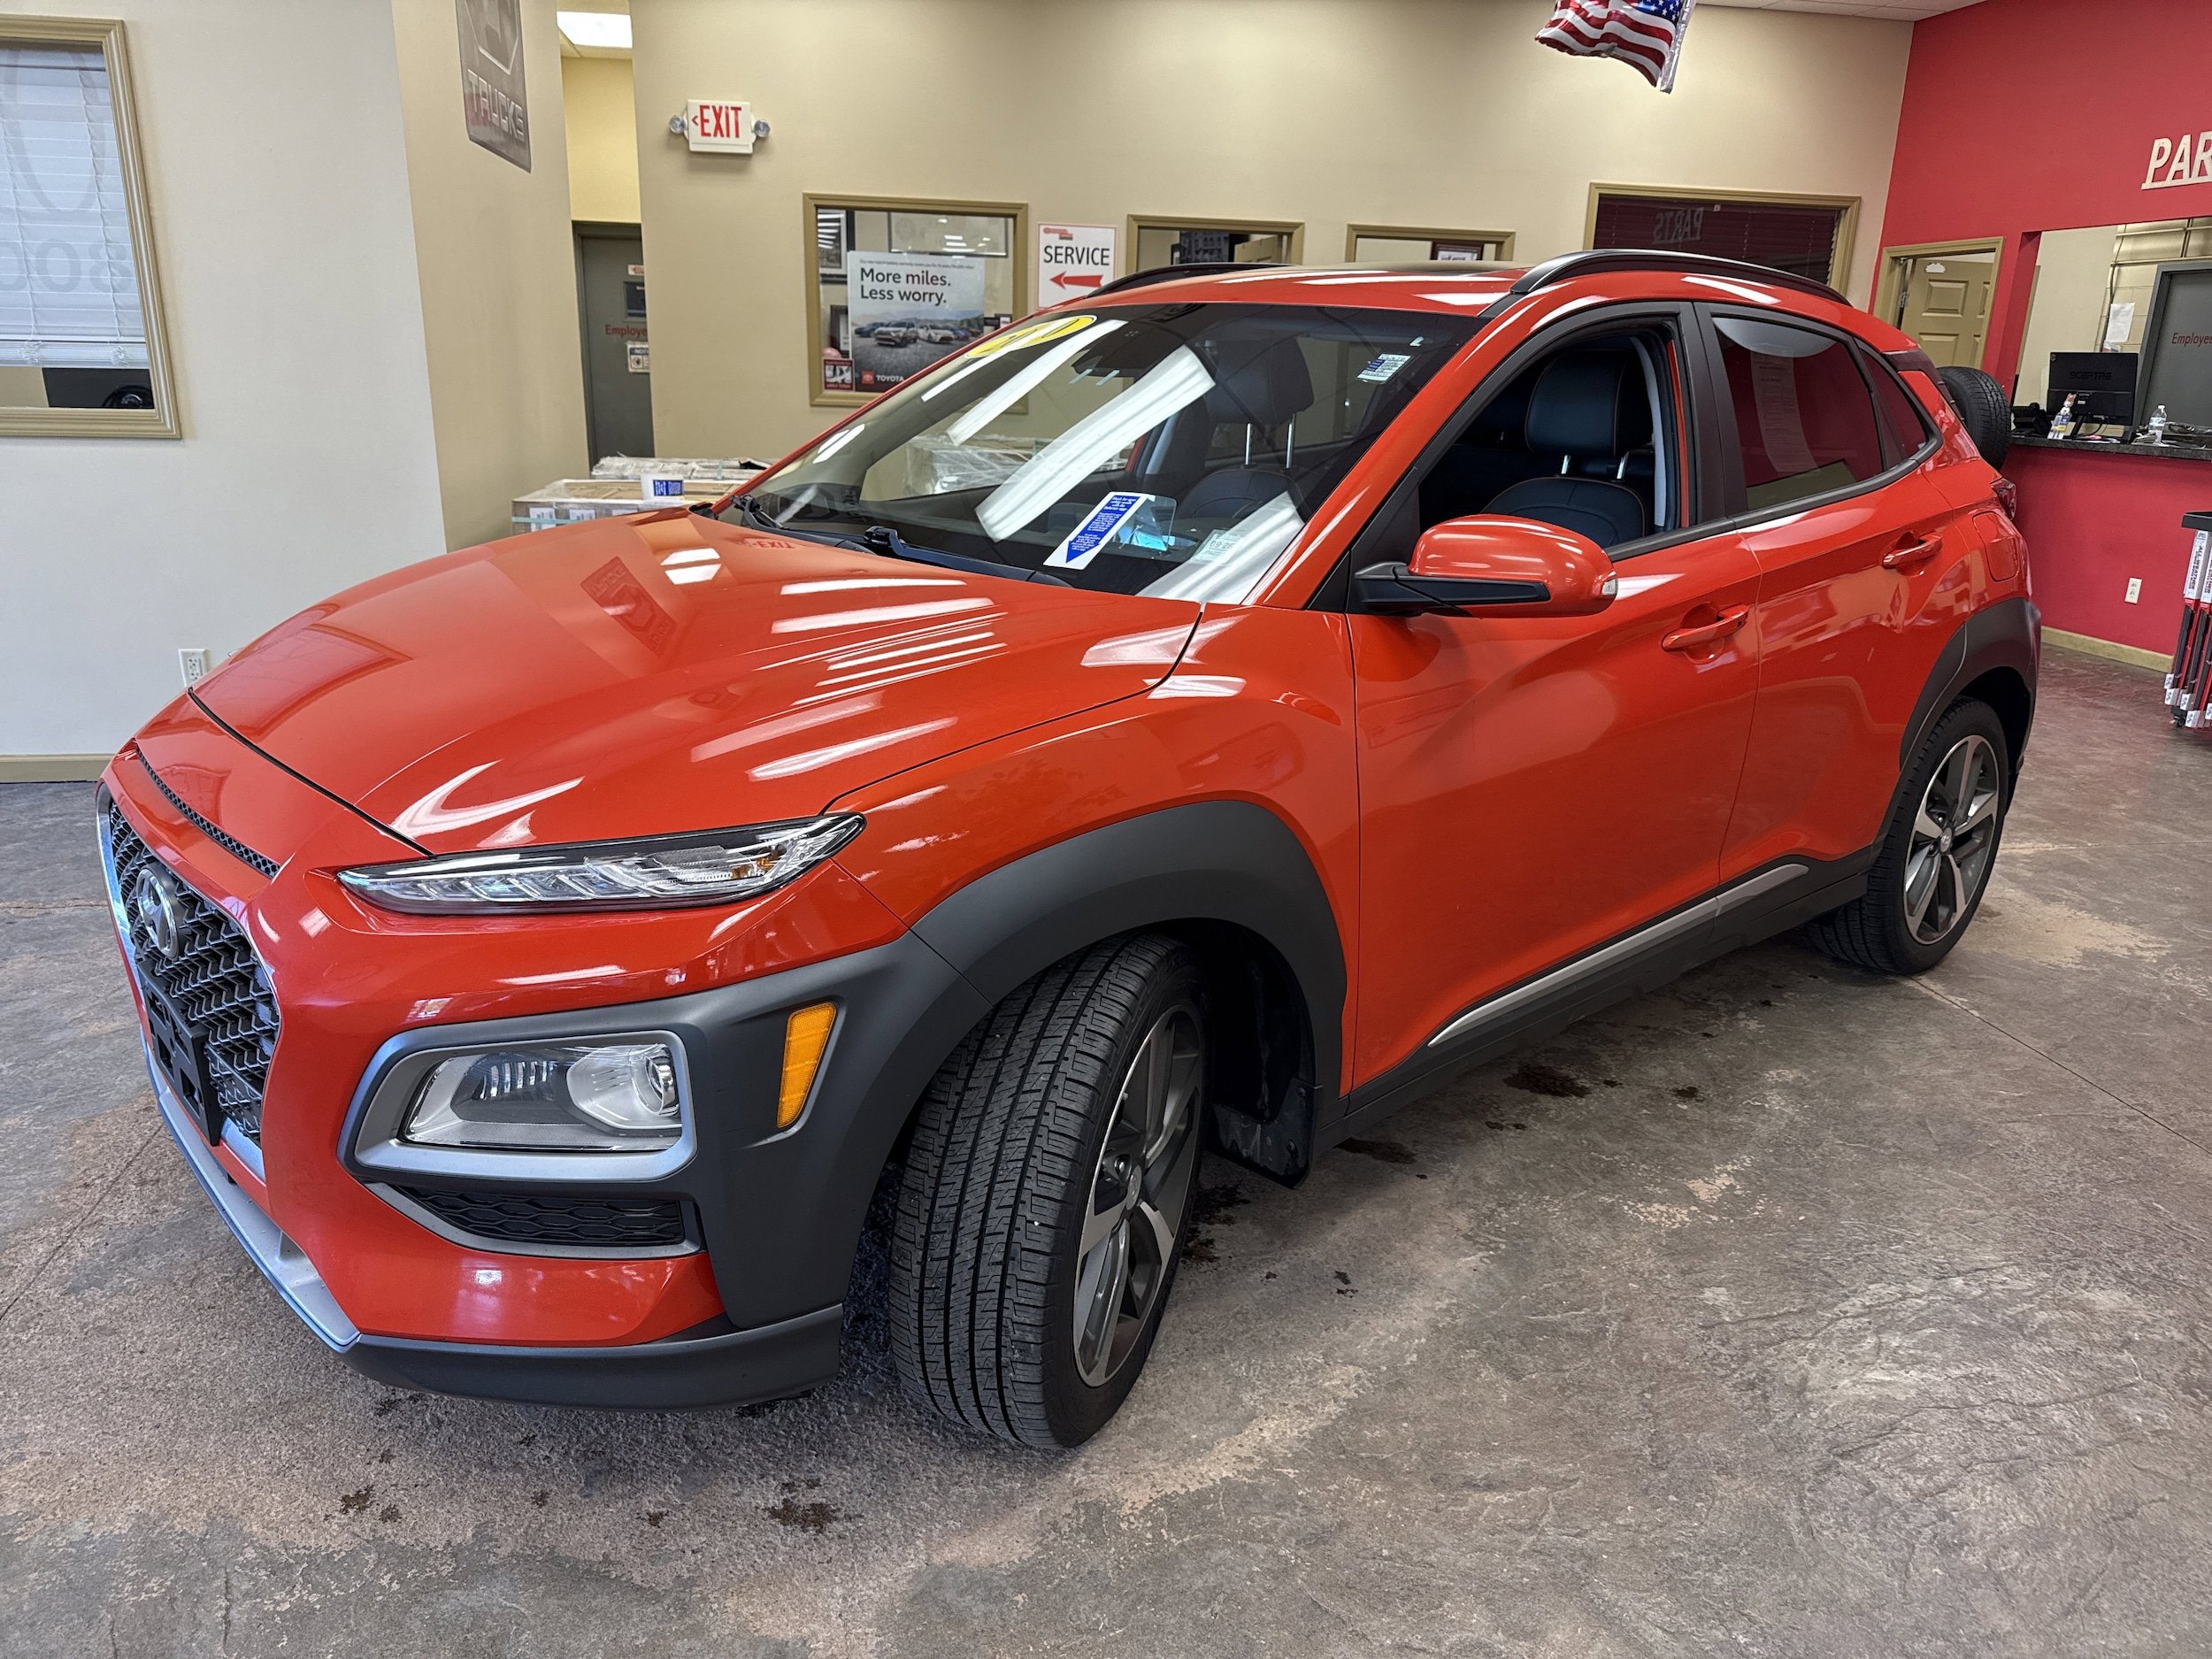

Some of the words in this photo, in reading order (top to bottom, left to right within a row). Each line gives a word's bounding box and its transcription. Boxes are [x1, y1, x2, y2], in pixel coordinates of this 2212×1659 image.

[467, 69, 525, 142] TRUCKS
[699, 104, 741, 138] EXIT
[2144, 130, 2212, 186] PAR
[1043, 245, 1110, 265] SERVICE
[860, 267, 901, 283] More
[906, 271, 951, 286] miles.
[861, 285, 894, 300] Less
[898, 290, 947, 306] worry.
[2069, 370, 2113, 380] SCEPTRE
